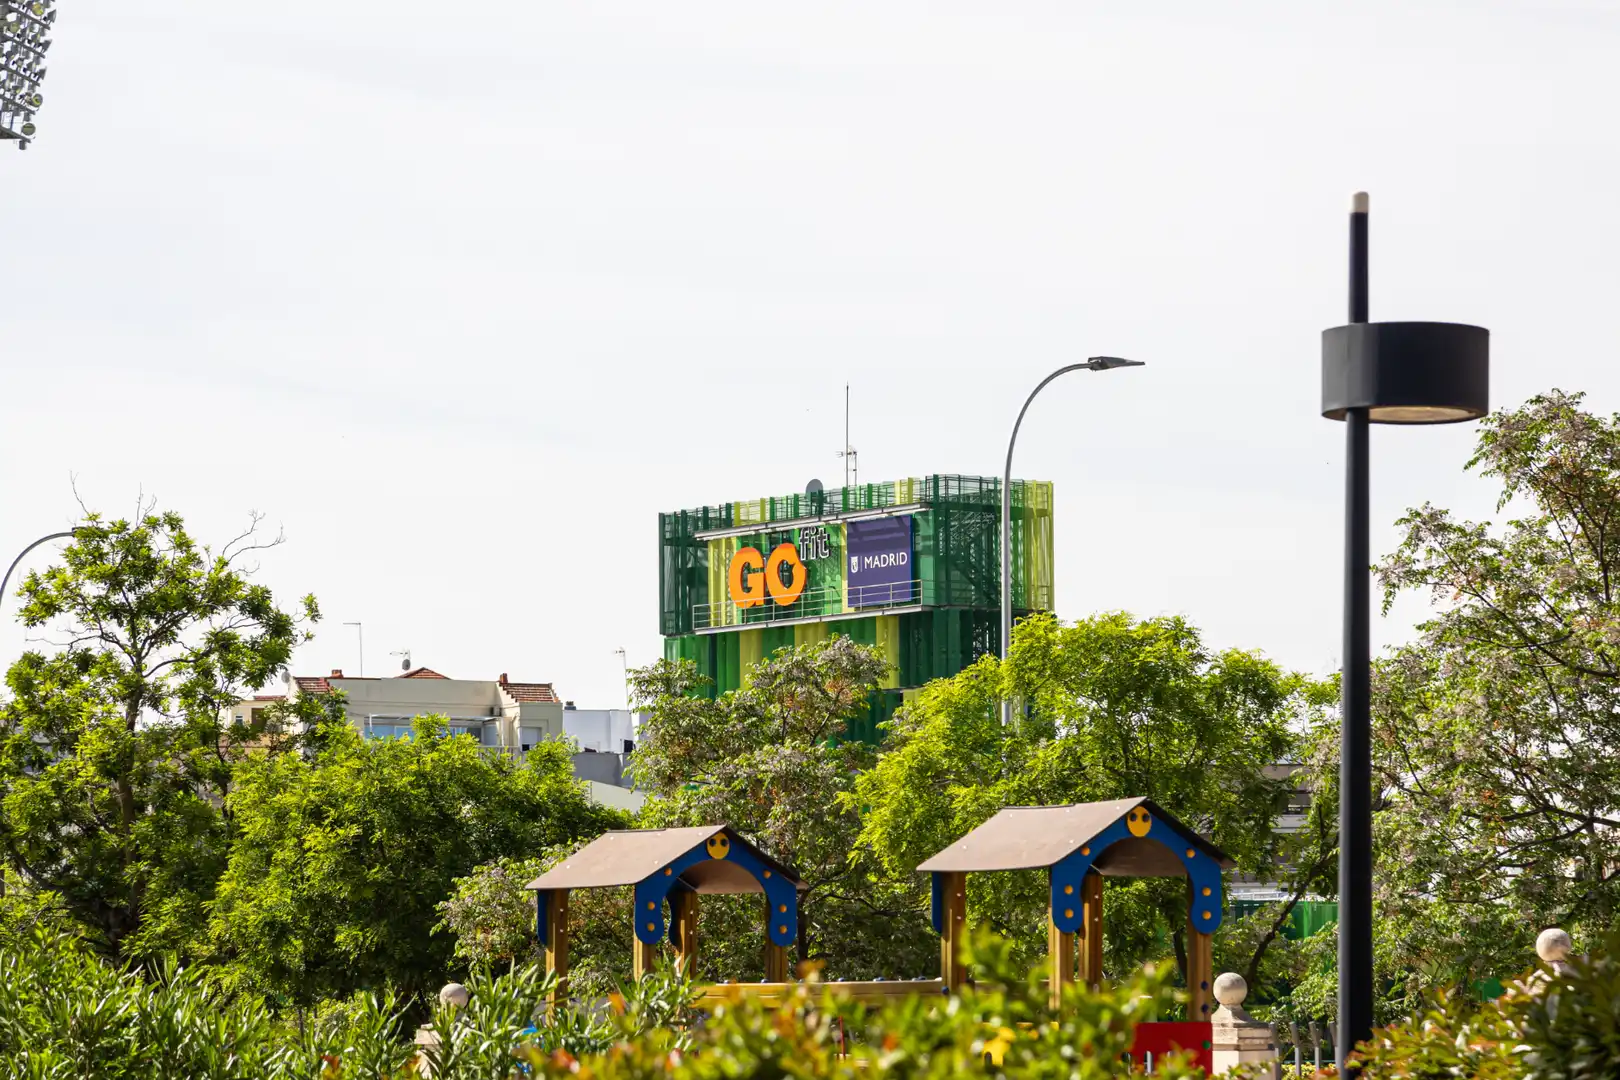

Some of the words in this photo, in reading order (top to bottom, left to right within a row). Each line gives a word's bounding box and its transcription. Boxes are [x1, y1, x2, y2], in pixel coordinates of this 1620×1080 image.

[728, 543, 807, 609] GO
[799, 526, 830, 561] fit
[864, 552, 908, 569] MADRID
